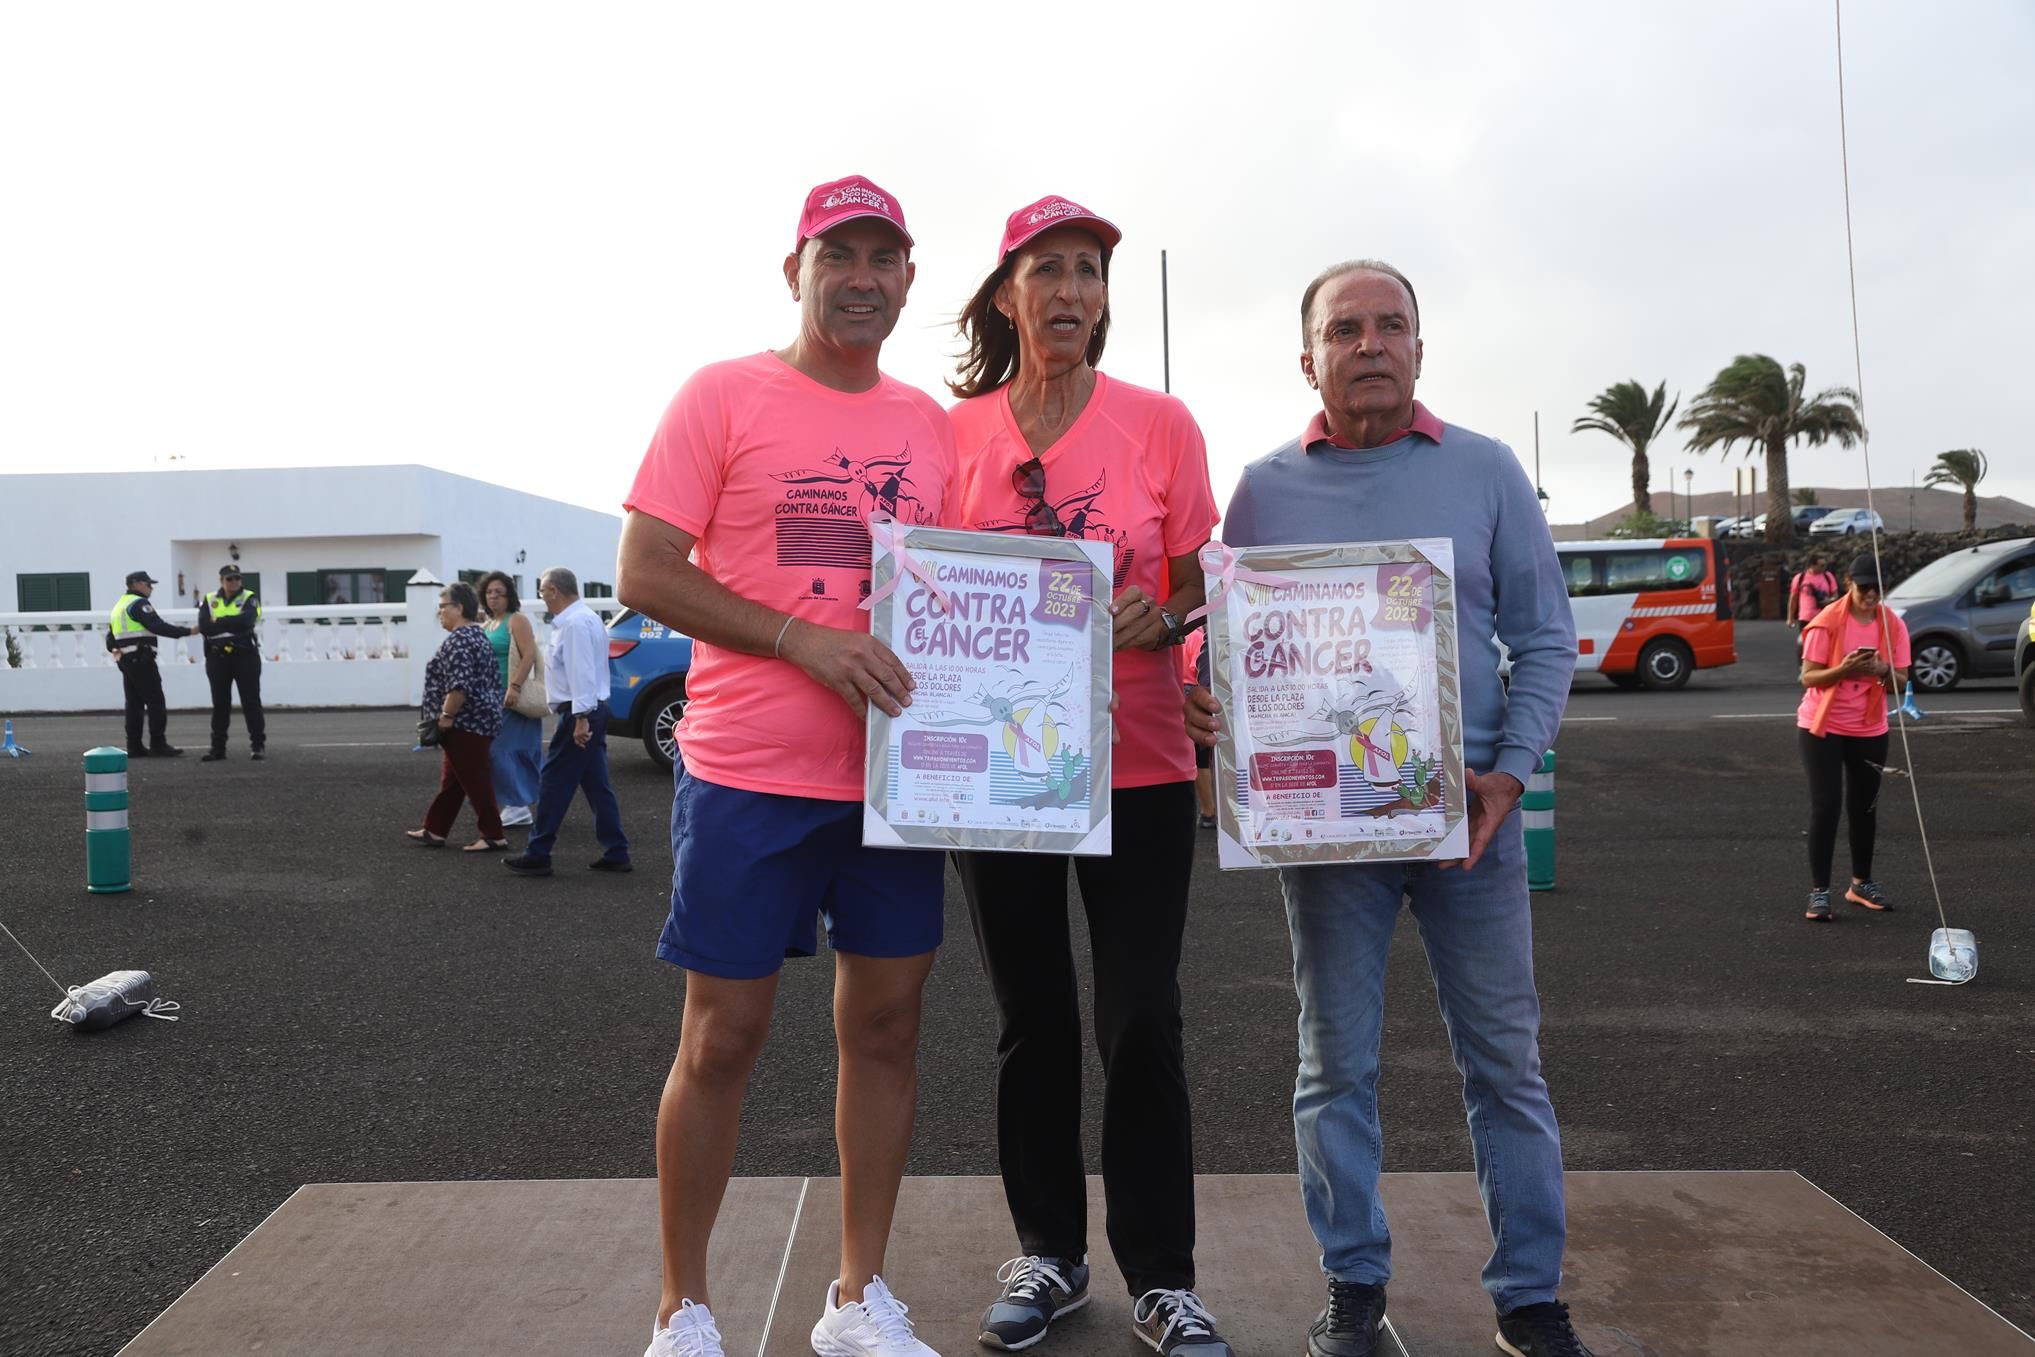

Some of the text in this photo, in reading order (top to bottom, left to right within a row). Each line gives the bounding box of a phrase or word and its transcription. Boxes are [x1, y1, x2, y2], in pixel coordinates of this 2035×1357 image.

[786, 489, 848, 501] CAMINAMOS
[775, 503, 819, 515] CONTRA
[937, 565, 1028, 590] CAMINAMOS
[1048, 572, 1082, 595] 22 DE
[1271, 582, 1365, 602] CAMINAMOS
[1387, 576, 1423, 597] 22 DE
[1046, 592, 1082, 604] OCTUBRE
[1386, 597, 1423, 606] OCTUBRE
[905, 588, 1027, 626] CONTRA
[1044, 601, 1076, 618] 2023
[1384, 606, 1418, 622] 2023
[1243, 606, 1366, 642] CONTRA
[640, 631, 663, 639] 092
[915, 628, 929, 641] EL
[910, 671, 962, 683] ESDE LA PLAZA
[930, 683, 961, 692] DOLORES
[1276, 684, 1289, 692] LAS
[1247, 692, 1305, 704] DESDE LA PLAZA
[1247, 702, 1305, 713] DE LOS DOLORES
[922, 774, 960, 783] BENEFICIO
